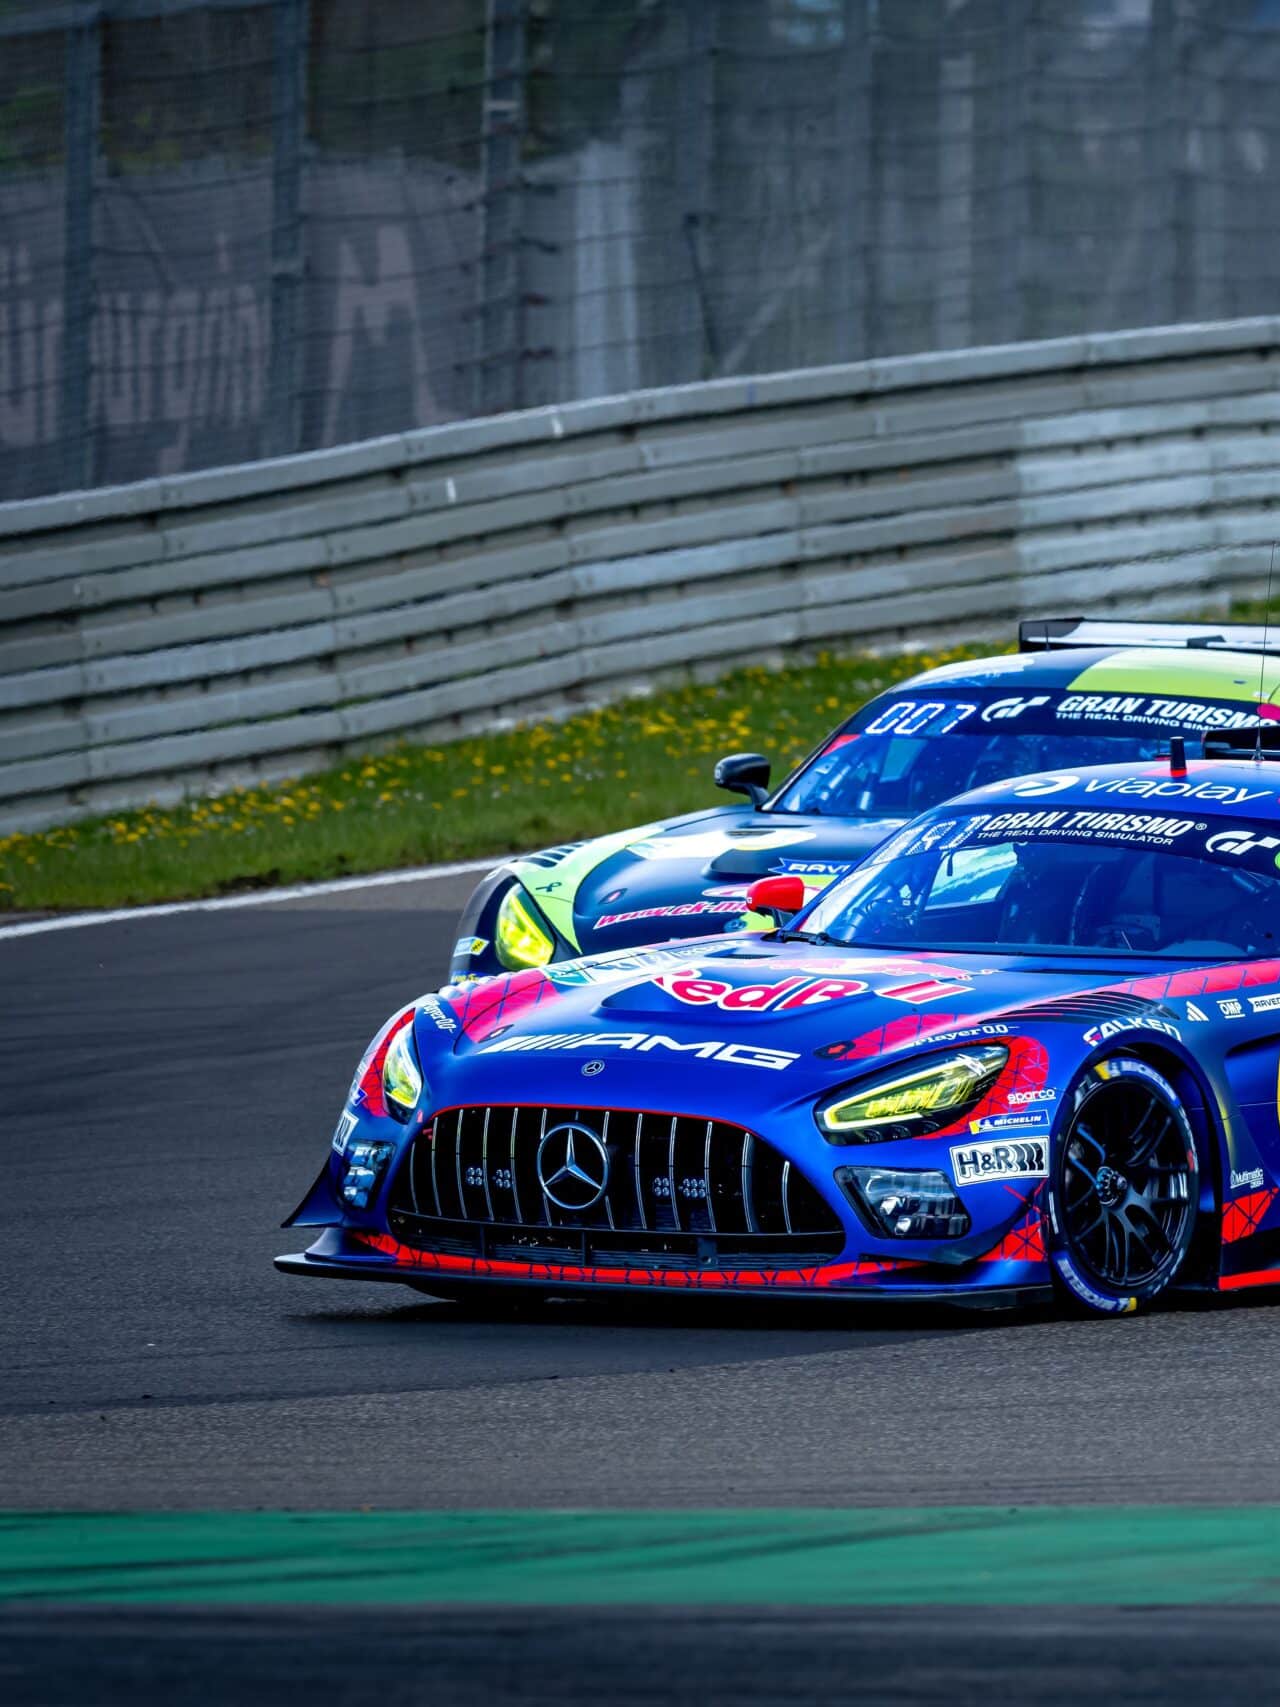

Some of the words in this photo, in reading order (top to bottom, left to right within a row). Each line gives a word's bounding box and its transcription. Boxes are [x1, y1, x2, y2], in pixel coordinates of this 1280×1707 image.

[1056, 696, 1146, 714] GRAN
[864, 702, 977, 734] 007
[1055, 712, 1082, 720] THE
[1084, 712, 1119, 721] REAL
[1122, 713, 1181, 727] DRIVING
[1084, 777, 1274, 805] viaplay
[982, 811, 1069, 831] GRAN
[976, 830, 1001, 840] THE
[1005, 829, 1035, 837] REAL
[1038, 829, 1093, 838] DRIVING
[1094, 830, 1174, 846] SIMULATOR
[1082, 1017, 1182, 1047] FALKEN
[1007, 1088, 1057, 1104] sparco
[993, 1115, 1042, 1126] MICHELIN
[957, 1145, 1013, 1177] H&R
